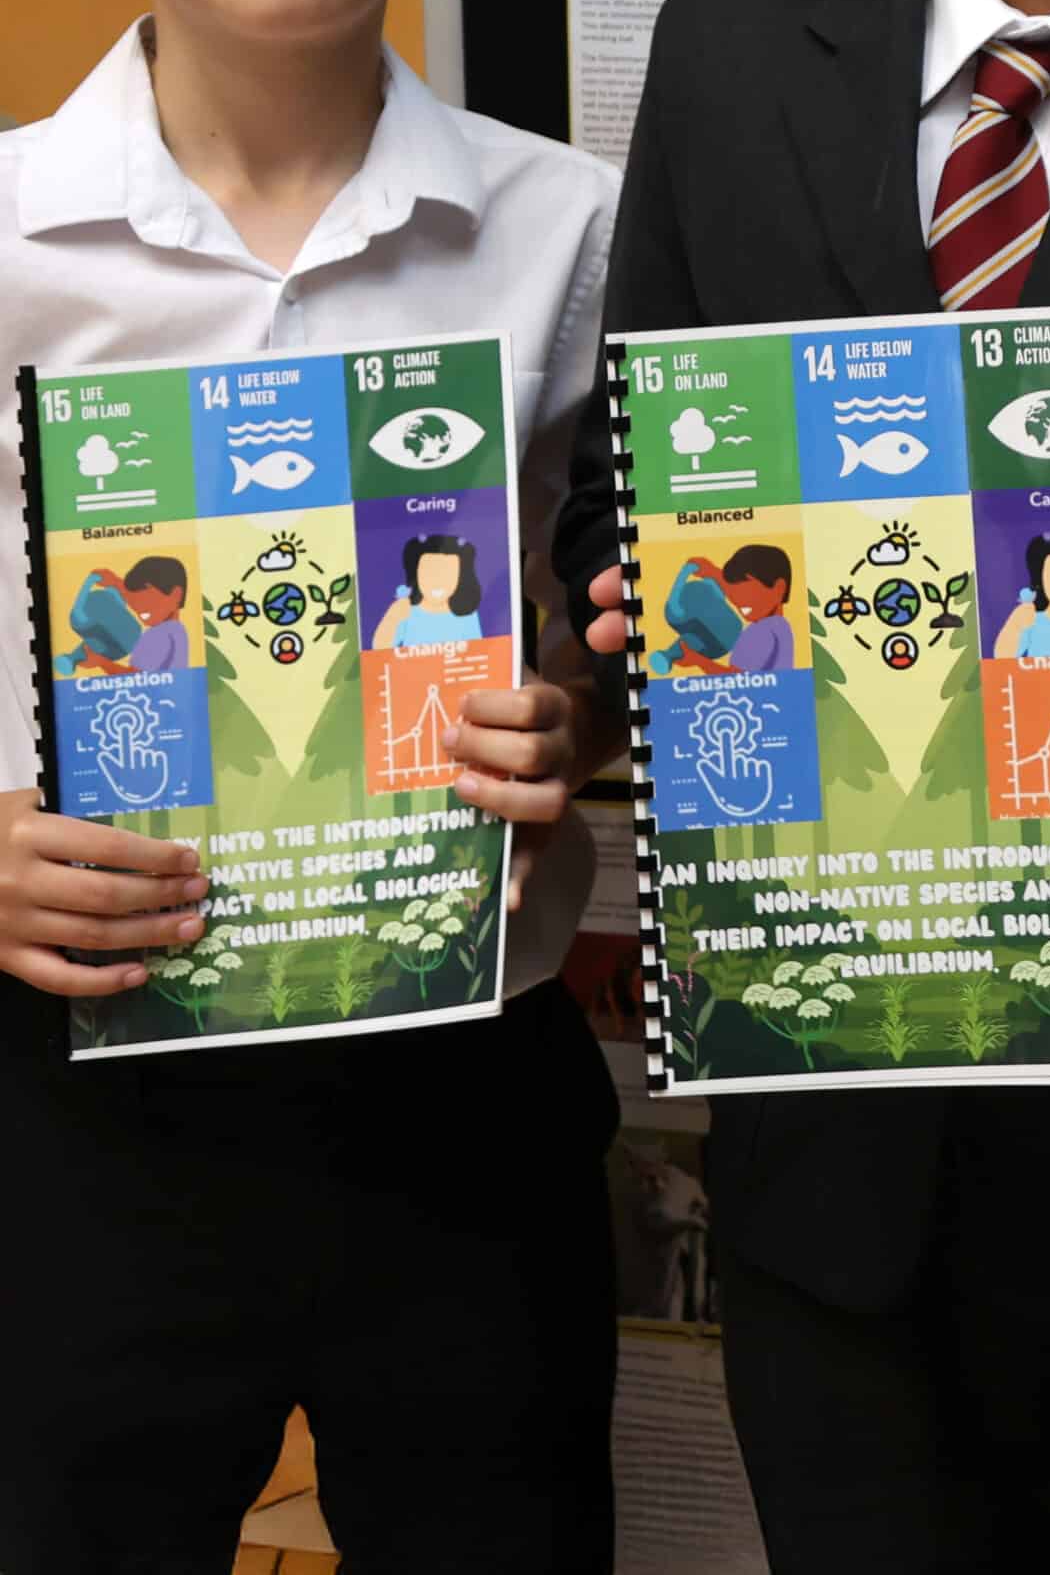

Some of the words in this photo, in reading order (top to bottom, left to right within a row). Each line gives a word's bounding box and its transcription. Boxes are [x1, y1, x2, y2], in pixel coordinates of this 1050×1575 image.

[392, 350, 442, 369] CLIMATE
[845, 341, 870, 360] LIFE
[871, 339, 913, 358] BELOW
[970, 328, 1004, 368] 13
[353, 356, 385, 393] 13
[673, 353, 699, 371] LIFE
[803, 344, 837, 383] 14
[846, 362, 888, 380] WATER
[237, 372, 260, 389] LIFE
[262, 369, 301, 386] BELOW
[394, 370, 436, 389] ACTION
[631, 356, 664, 394] 15
[675, 375, 692, 392] ON
[695, 372, 728, 390] LAND
[79, 385, 105, 402] LIFE
[199, 375, 231, 410] 14
[239, 390, 277, 407] WATER
[41, 388, 73, 424] 15
[81, 405, 99, 421] ON
[100, 402, 131, 418] LAND
[405, 496, 457, 514] Caring
[677, 507, 754, 526] Balanced
[82, 523, 154, 541] Balanced
[394, 638, 468, 660] Change
[75, 669, 174, 694] Causation
[672, 670, 777, 695] Causation
[209, 830, 265, 856] INTO
[272, 825, 316, 848] THE
[323, 807, 476, 845] INTRODUCTION
[301, 849, 387, 877] SPECIES
[392, 844, 436, 868] AND
[660, 862, 698, 887] AN
[706, 855, 809, 883] INQUIRY
[818, 851, 879, 876] INTO
[887, 848, 935, 873] THE
[263, 890, 296, 912] ON
[303, 883, 368, 908] LOCAL
[374, 868, 480, 901] BIOLOGICAL
[754, 883, 910, 915] NON-NATIVE
[919, 879, 1016, 906] SPECIES
[229, 914, 370, 948] EQUILIBRIUM.
[692, 926, 767, 953] THEIR
[775, 919, 869, 948] IMPACT
[877, 917, 913, 942] ON
[921, 915, 995, 940] LOCAL
[840, 949, 1000, 979] EQUILIBRIUM.
